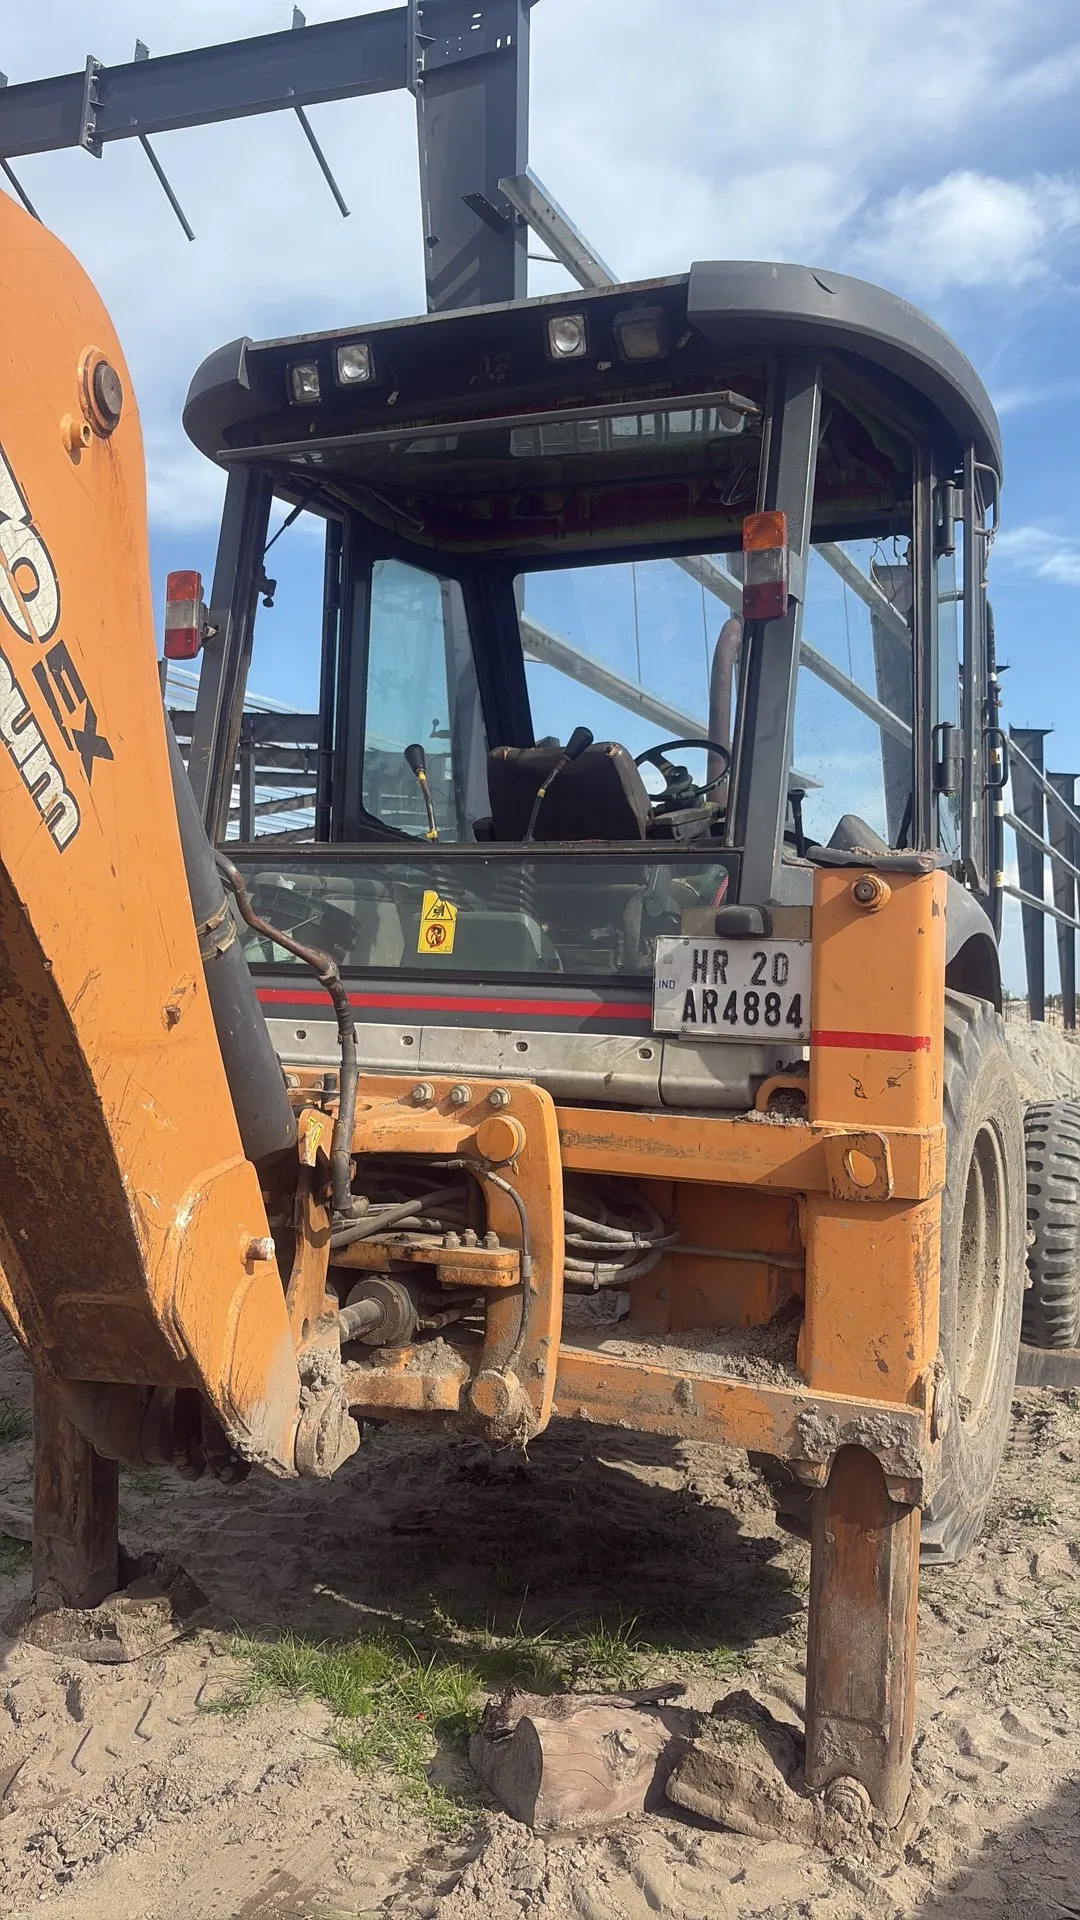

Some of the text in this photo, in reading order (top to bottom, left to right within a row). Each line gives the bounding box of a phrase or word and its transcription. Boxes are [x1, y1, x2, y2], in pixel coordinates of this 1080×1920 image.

[657, 979, 676, 990] IND
[691, 948, 789, 987] HR 20
[682, 988, 803, 1029] AR4884
